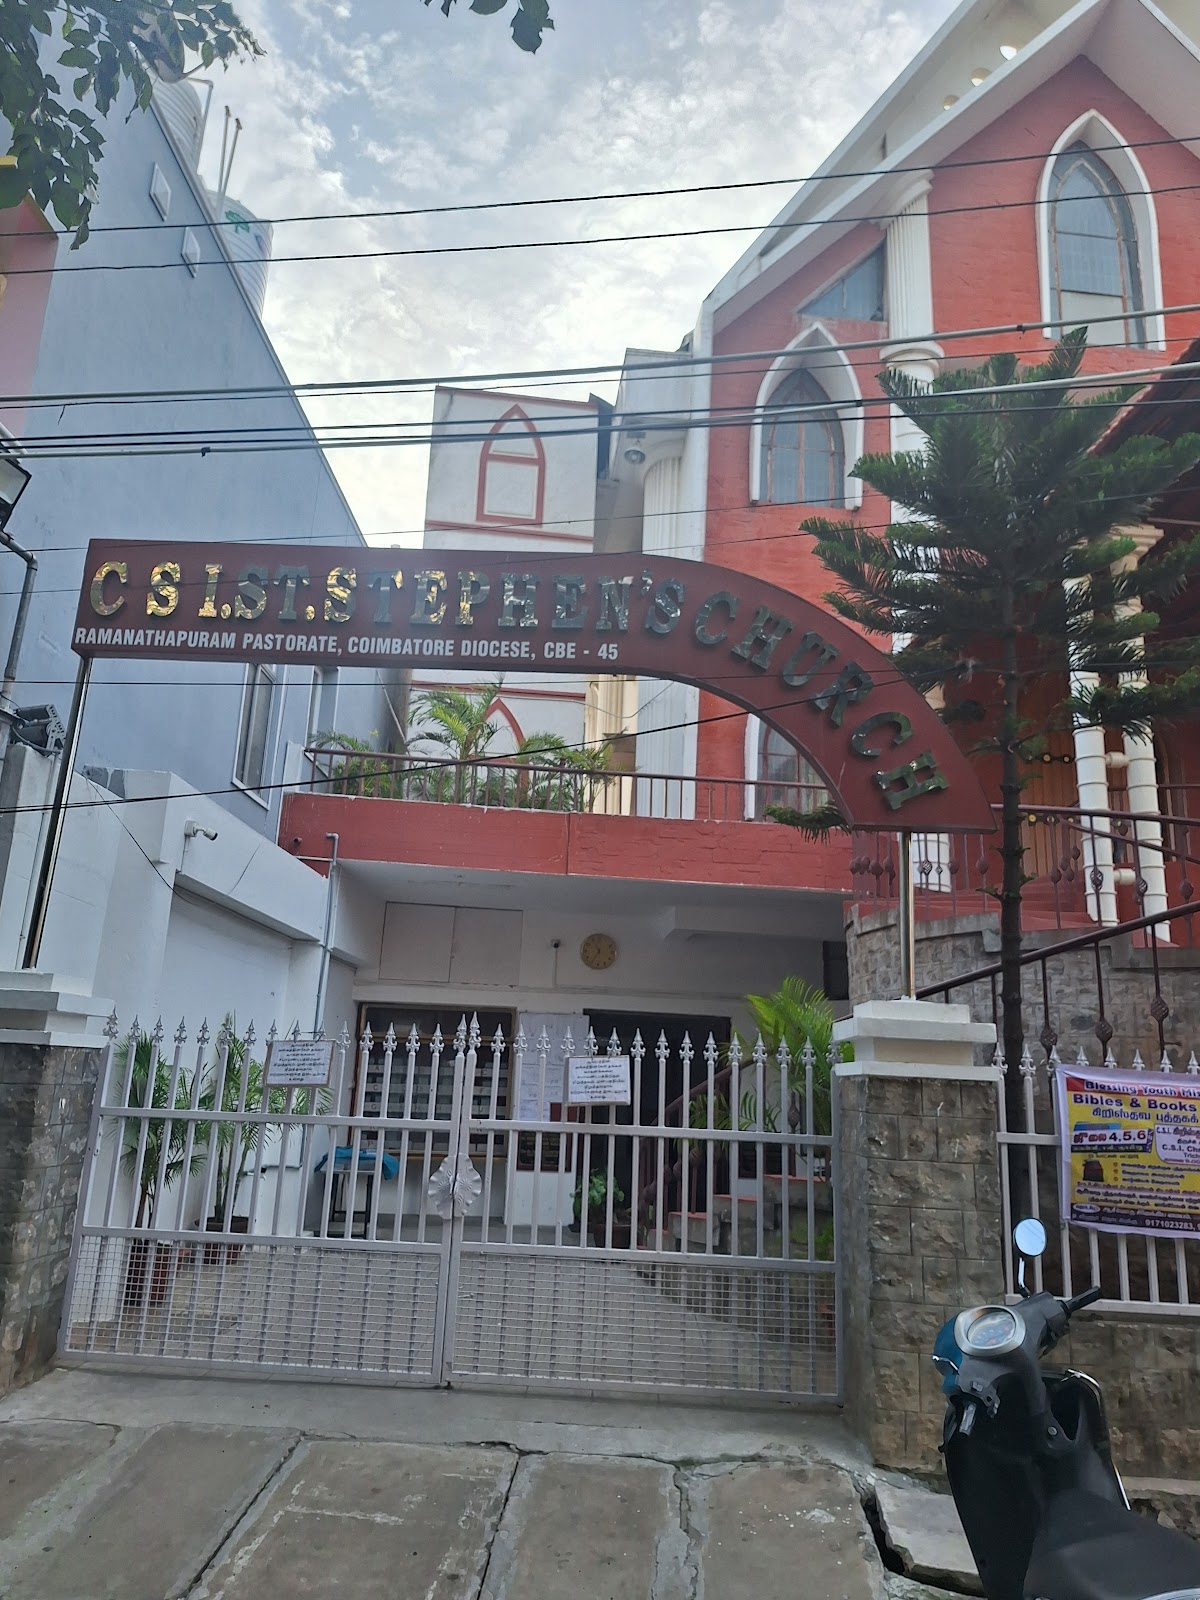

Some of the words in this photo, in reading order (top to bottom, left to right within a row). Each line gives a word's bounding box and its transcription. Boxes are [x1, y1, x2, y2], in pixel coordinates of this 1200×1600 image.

[75, 627, 236, 649] RAMANATHAPURAM
[242, 633, 342, 656] PASTORATE,
[347, 636, 454, 657] COIMBATORE
[461, 640, 536, 660] DIOCESE,
[543, 642, 576, 660] CBE
[597, 643, 619, 660] 45
[695, 591, 949, 810] CHURCH
[1085, 1081, 1136, 1094] Blessing
[1142, 1085, 1176, 1096] Youth
[1073, 1093, 1123, 1107] Bibles
[1129, 1098, 1141, 1108] &
[1147, 1098, 1197, 1112] Books
